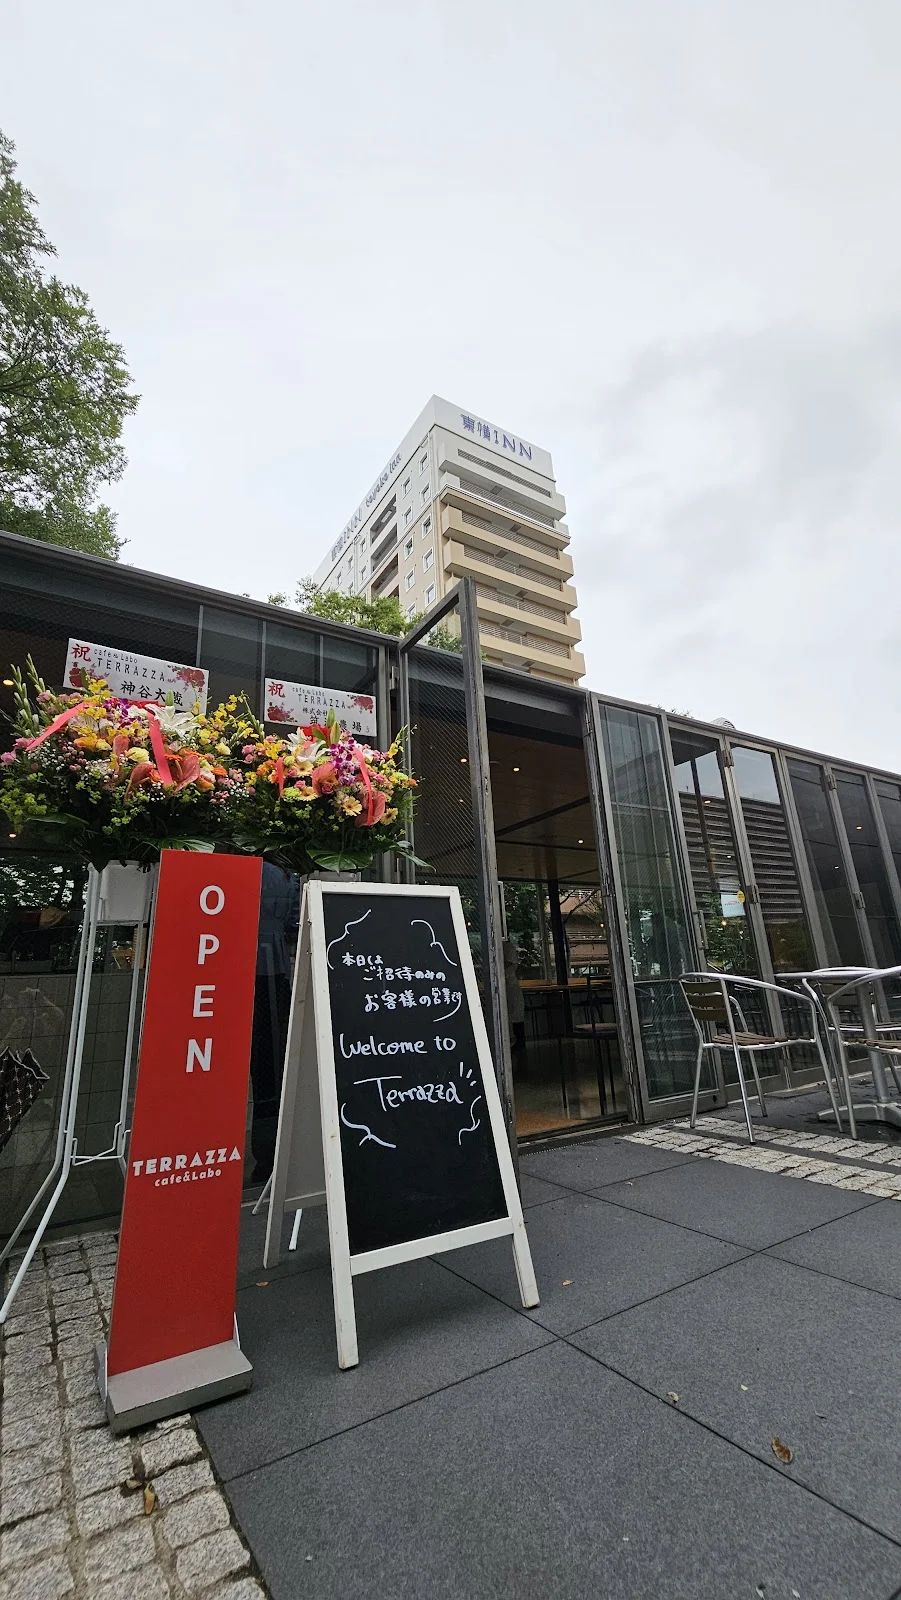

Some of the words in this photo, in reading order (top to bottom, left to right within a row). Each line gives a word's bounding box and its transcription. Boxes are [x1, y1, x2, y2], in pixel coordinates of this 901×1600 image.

[460, 413, 532, 461] 東横INN
[71, 643, 92, 663] 祝
[97, 657, 165, 682] TERRAZZA
[268, 681, 285, 698] 祝
[298, 694, 346, 709] TERRAZZA
[342, 951, 383, 966] 本日は
[186, 885, 225, 1073] OPEN
[363, 966, 446, 981] ご招待のみの
[340, 1033, 427, 1058] Welcome
[434, 1036, 456, 1051] to
[353, 1076, 464, 1112] Terrazza
[133, 1146, 241, 1177] TERRAZZA
[155, 1168, 221, 1187] cafe&Labo
